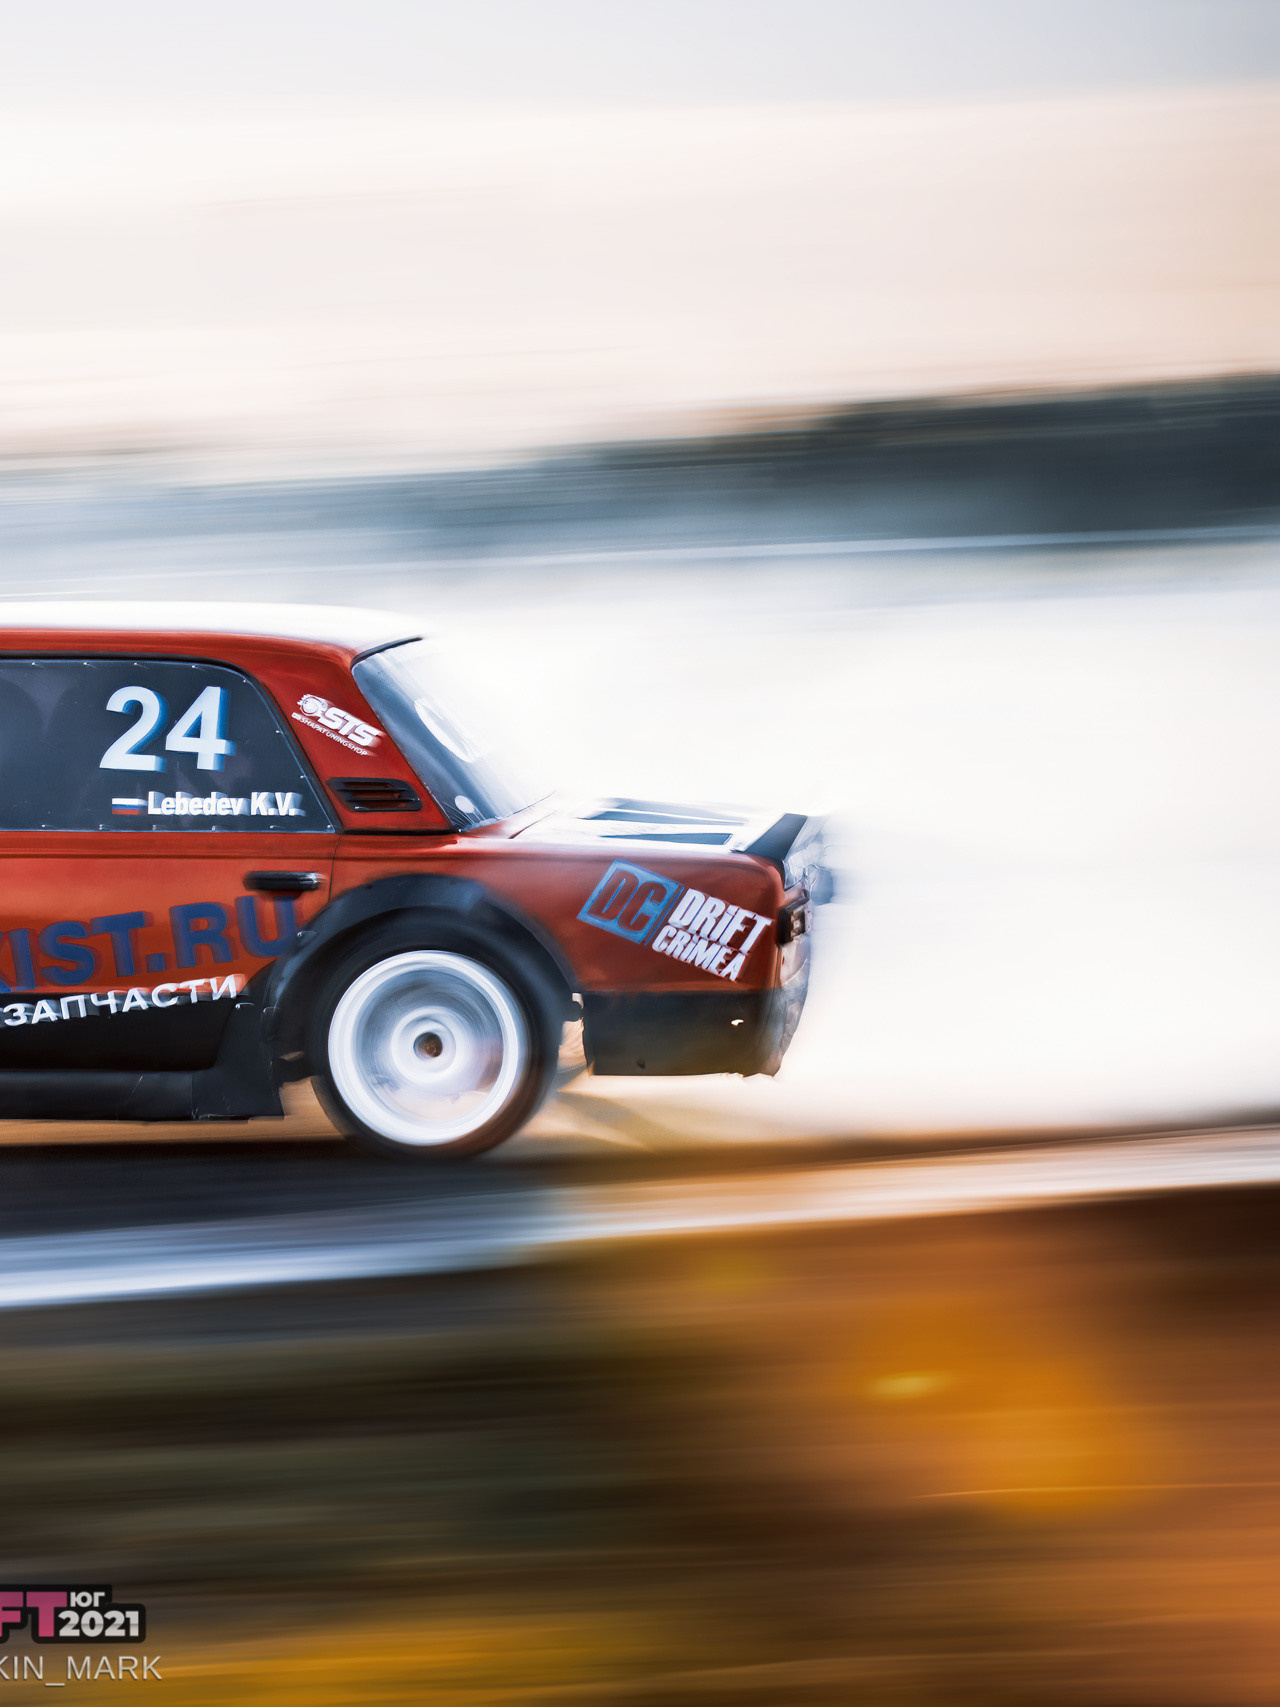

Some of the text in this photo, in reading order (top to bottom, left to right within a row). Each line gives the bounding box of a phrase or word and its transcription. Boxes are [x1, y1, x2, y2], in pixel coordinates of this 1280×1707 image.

[99, 685, 229, 770] 24
[317, 706, 381, 747] STS
[147, 790, 302, 817] Lebedev K.V.
[586, 869, 669, 933] DC
